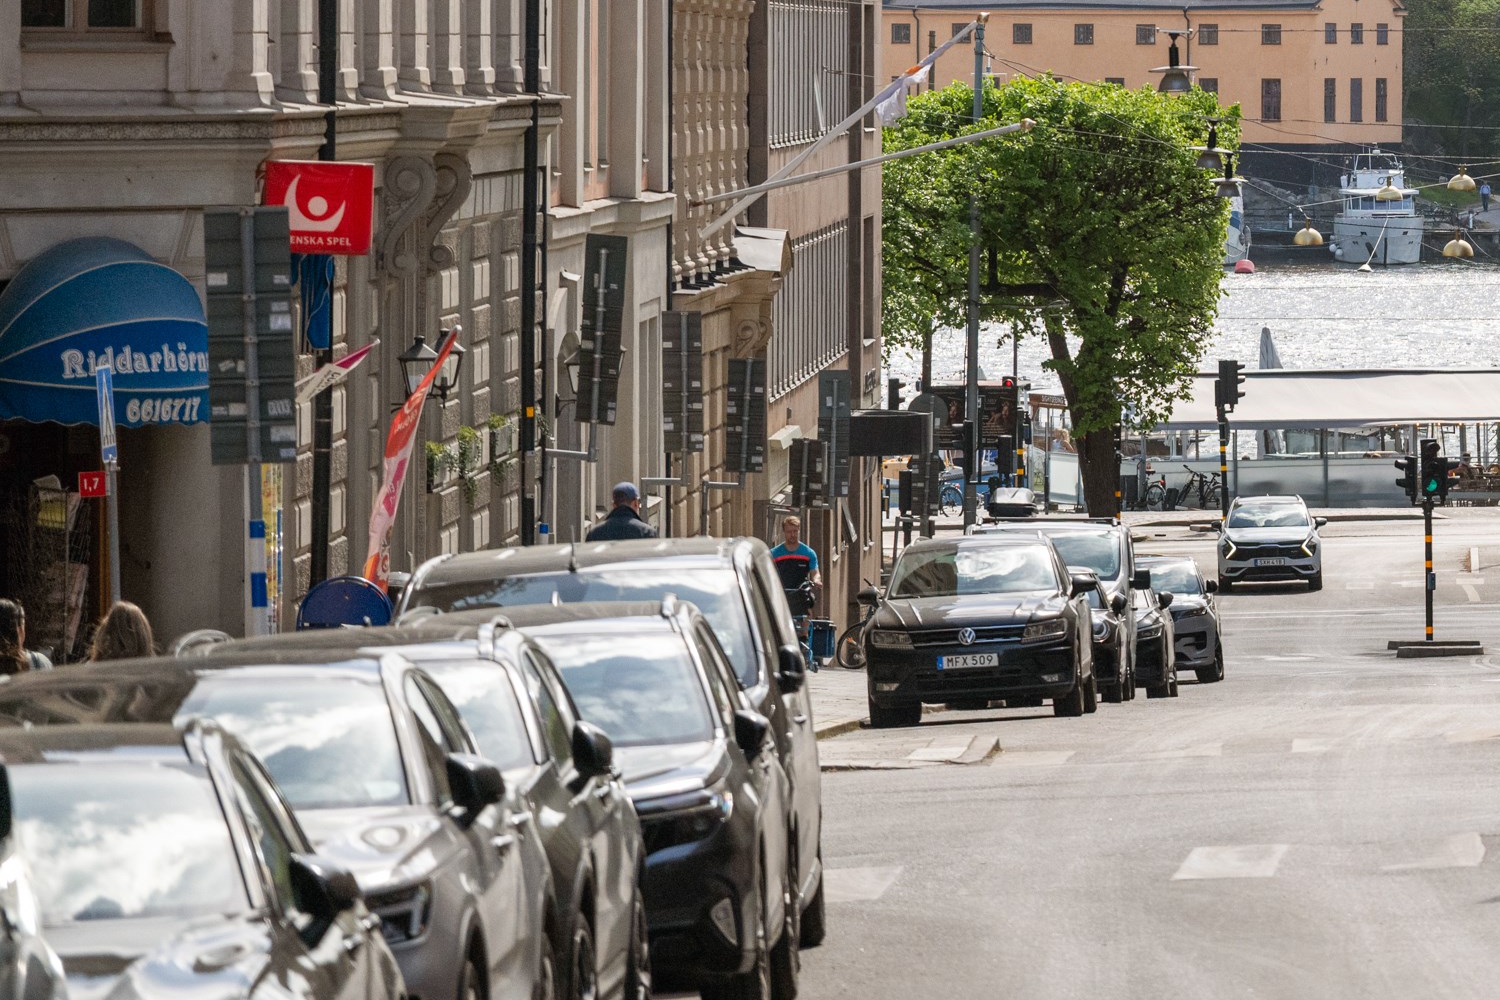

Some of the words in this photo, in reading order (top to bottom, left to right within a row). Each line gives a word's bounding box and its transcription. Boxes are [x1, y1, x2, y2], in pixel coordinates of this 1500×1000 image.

[290, 235, 324, 245] ENSKA
[326, 236, 352, 246] SPEL
[61, 341, 208, 379] Riddarhörn
[126, 396, 201, 423] 6616717
[83, 477, 99, 492] 1,7
[946, 656, 969, 667] MFX
[971, 654, 993, 666] 509
